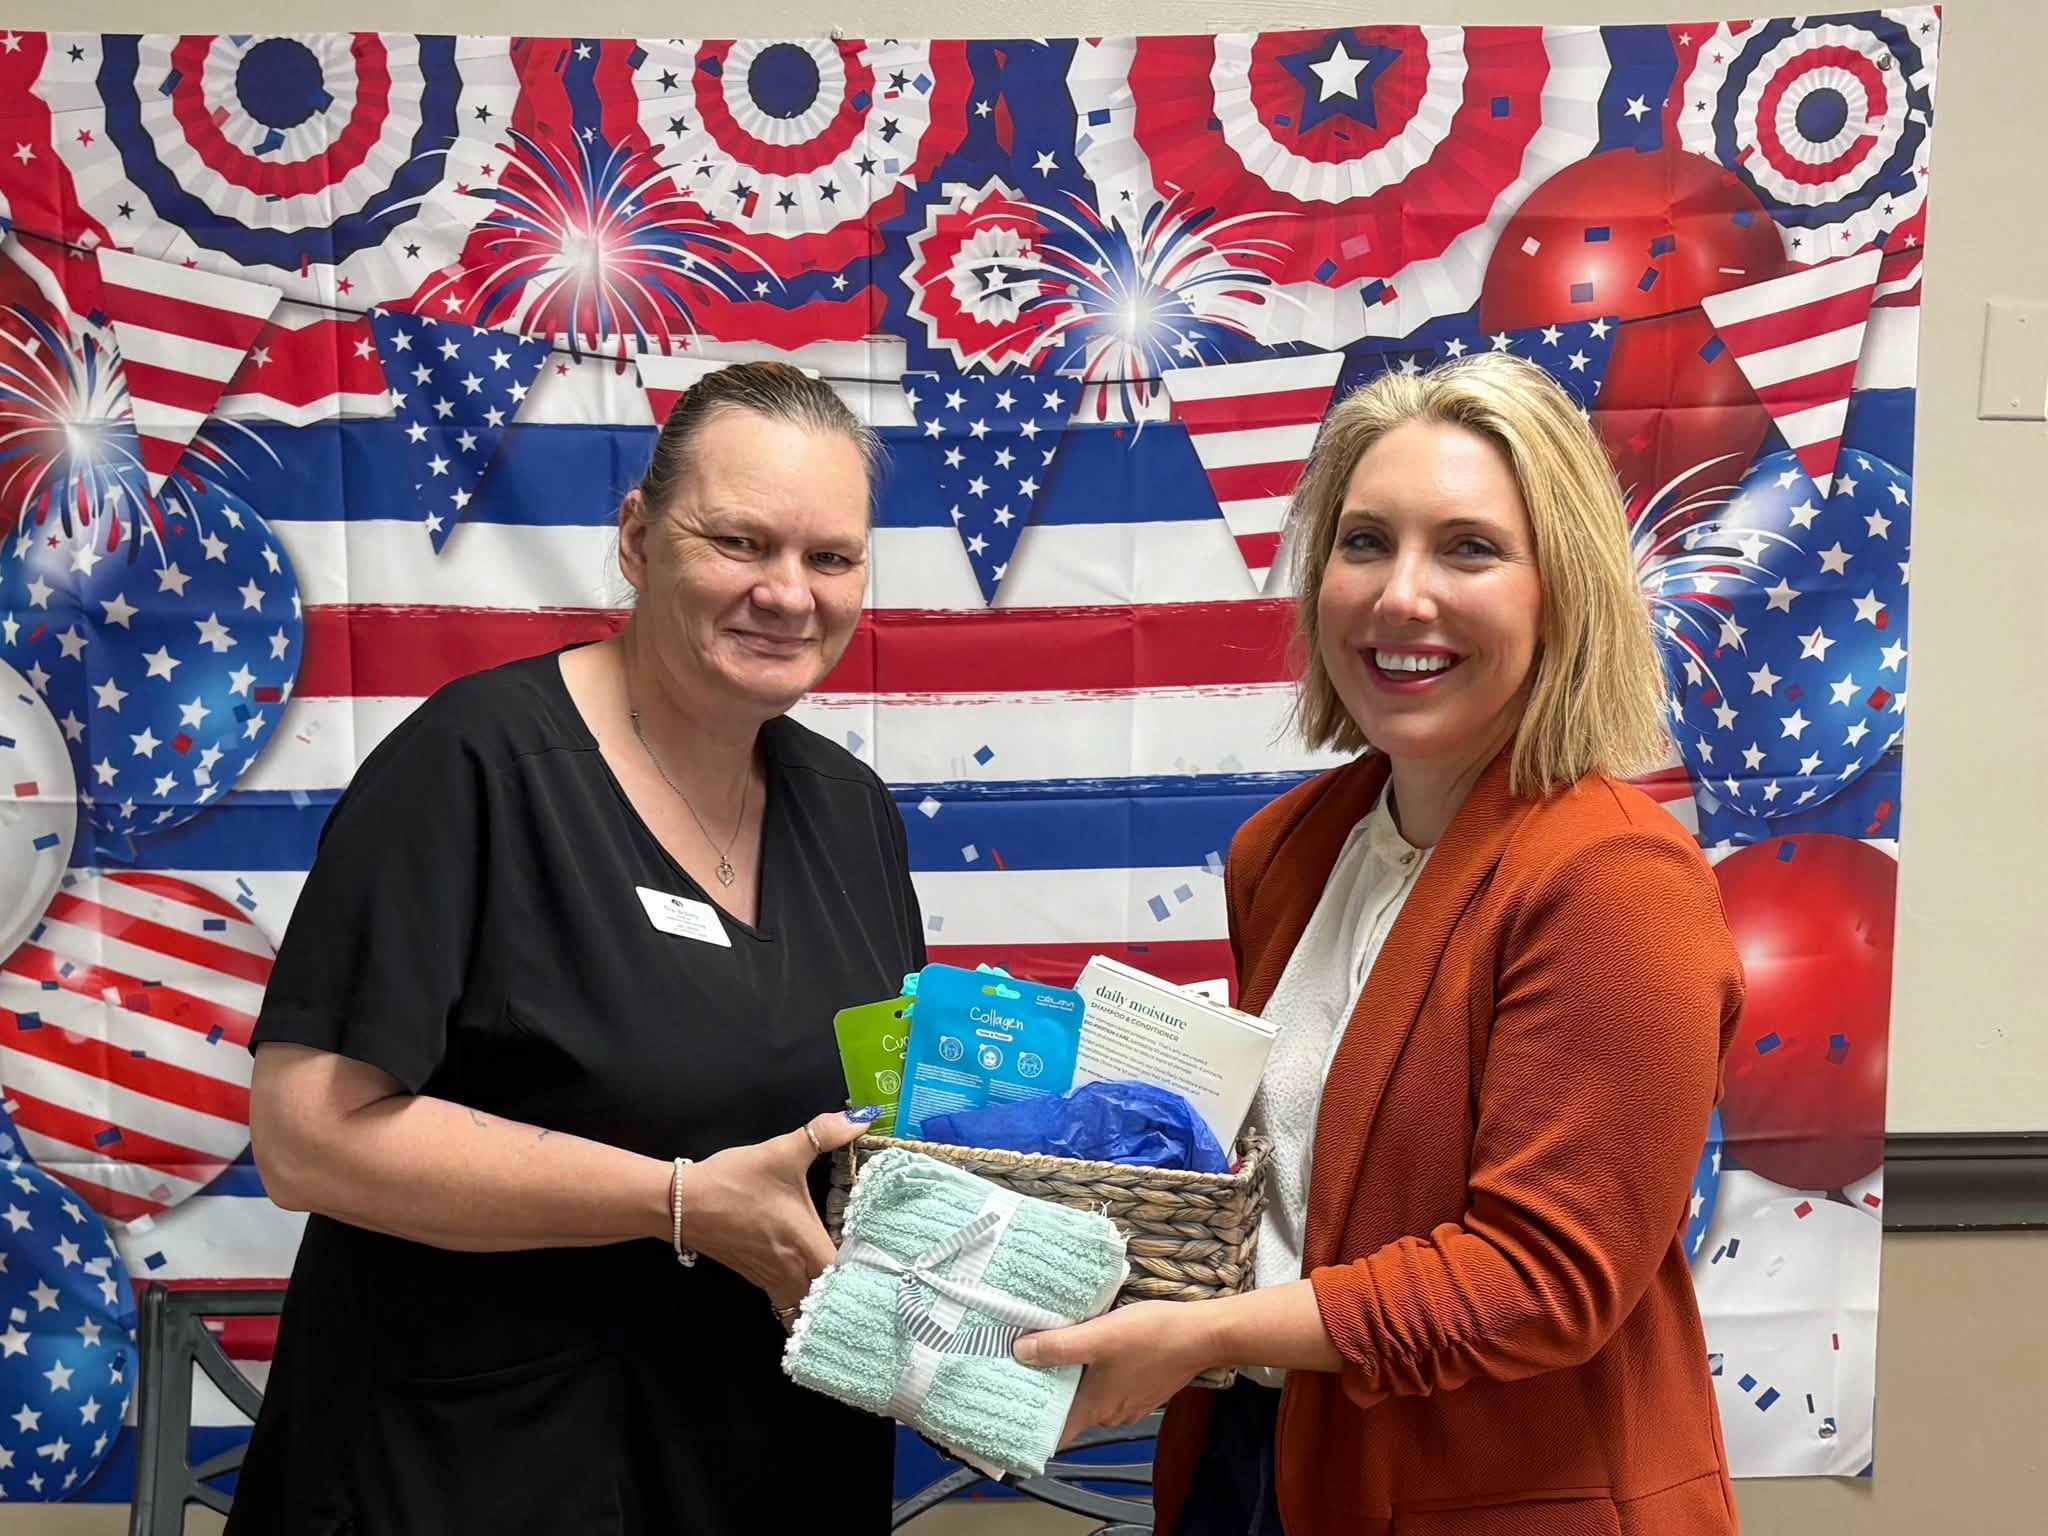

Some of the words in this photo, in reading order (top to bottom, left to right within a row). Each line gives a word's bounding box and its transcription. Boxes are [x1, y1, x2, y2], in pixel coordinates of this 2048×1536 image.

[970, 1006, 1024, 1031] Collagen
[1095, 986, 1128, 1008] daily
[1129, 1000, 1188, 1030] moisture
[1131, 1018, 1180, 1042] CONDITIONER
